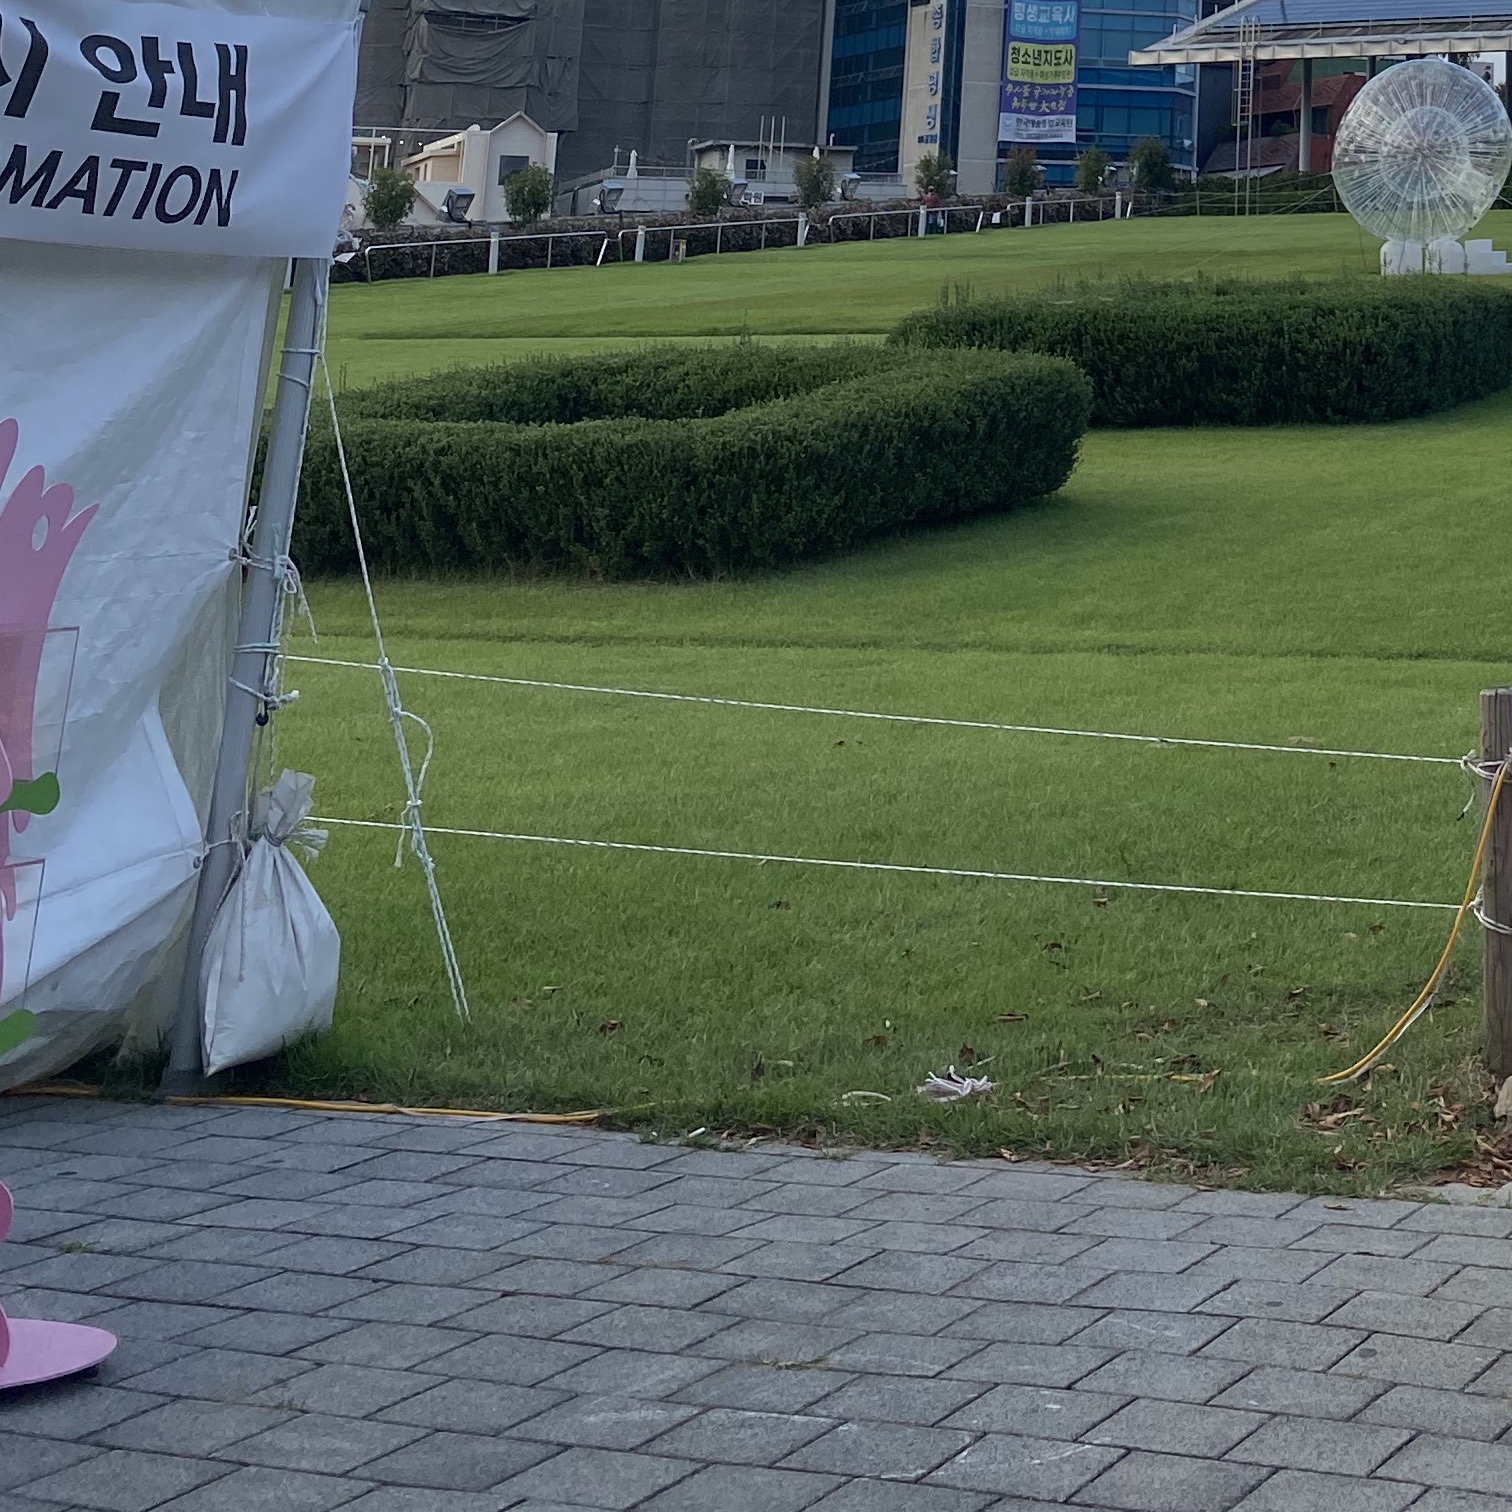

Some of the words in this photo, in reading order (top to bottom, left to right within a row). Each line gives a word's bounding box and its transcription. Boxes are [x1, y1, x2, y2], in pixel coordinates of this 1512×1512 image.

[1014, 1, 1076, 24] 평생교육사
[1010, 45, 1074, 67] 청소년지도사
[79, 34, 249, 146] 안내
